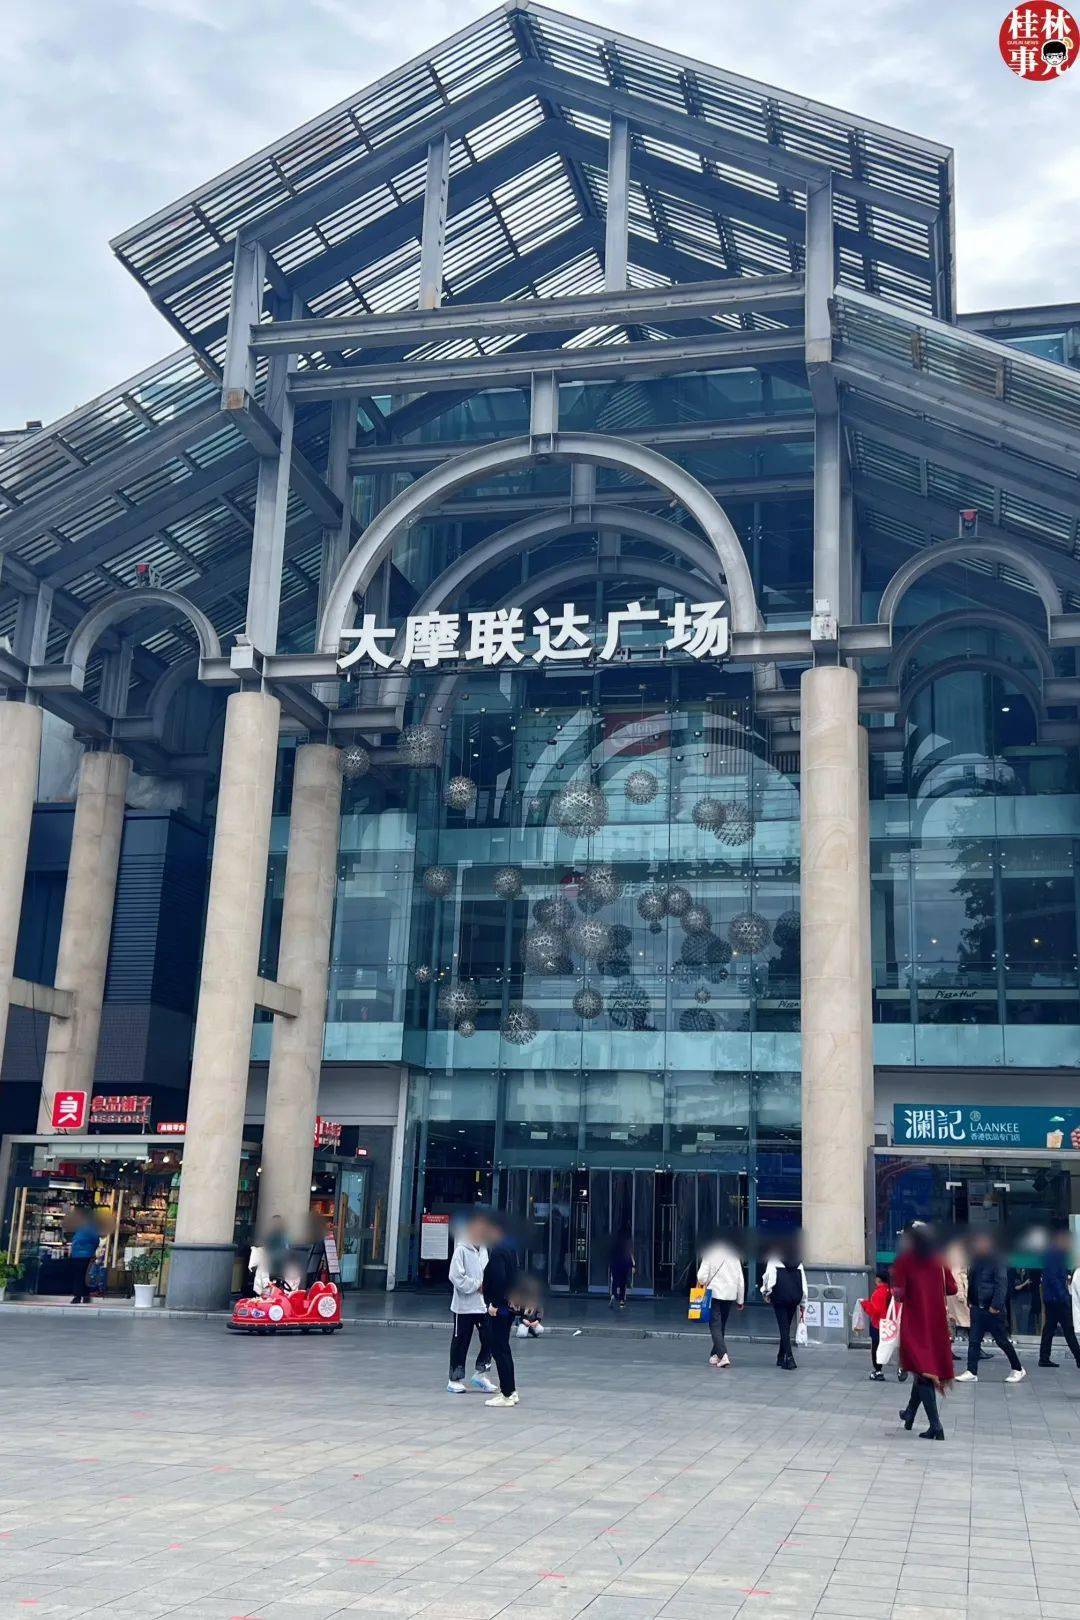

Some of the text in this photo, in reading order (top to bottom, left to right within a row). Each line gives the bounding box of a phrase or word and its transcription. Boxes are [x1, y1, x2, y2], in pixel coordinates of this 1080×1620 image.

[336, 600, 730, 670] 大摩联达广场
[970, 1122, 1020, 1133] LAANKEE
